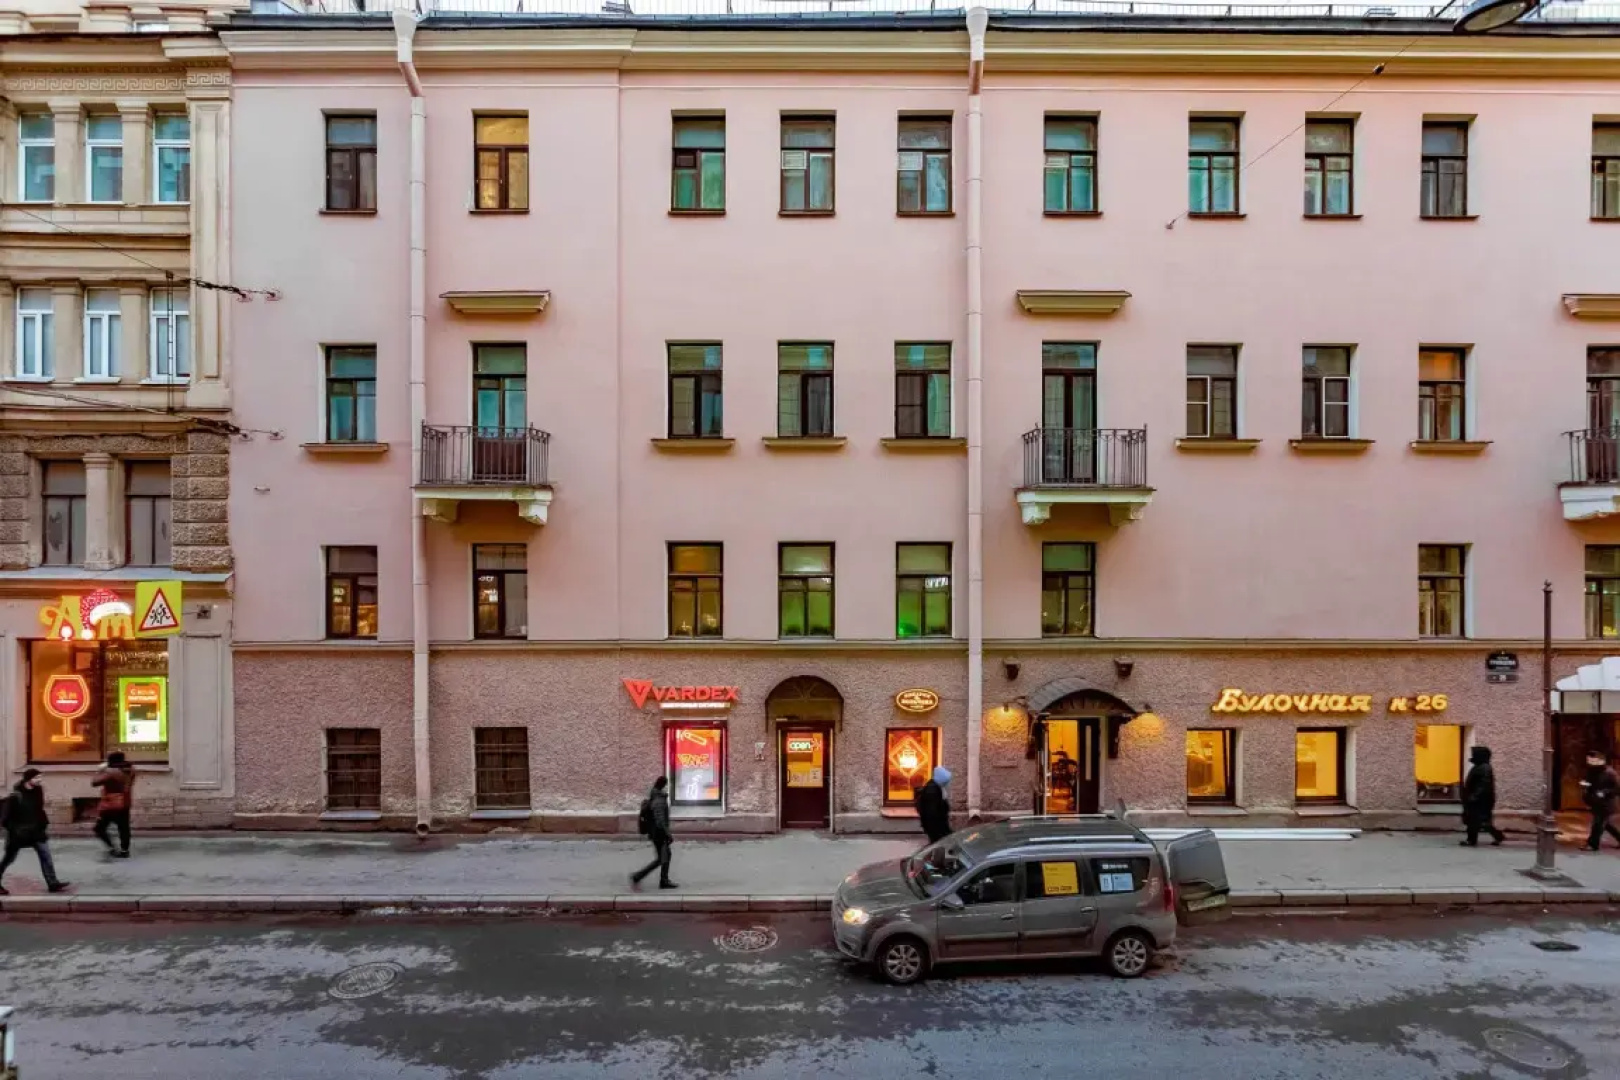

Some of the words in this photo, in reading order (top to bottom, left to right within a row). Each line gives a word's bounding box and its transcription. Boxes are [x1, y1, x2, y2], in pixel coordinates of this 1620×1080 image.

[652, 685, 739, 701] VARDEX
[1211, 688, 1372, 712] Булочная
[1415, 694, 1448, 710] 26
